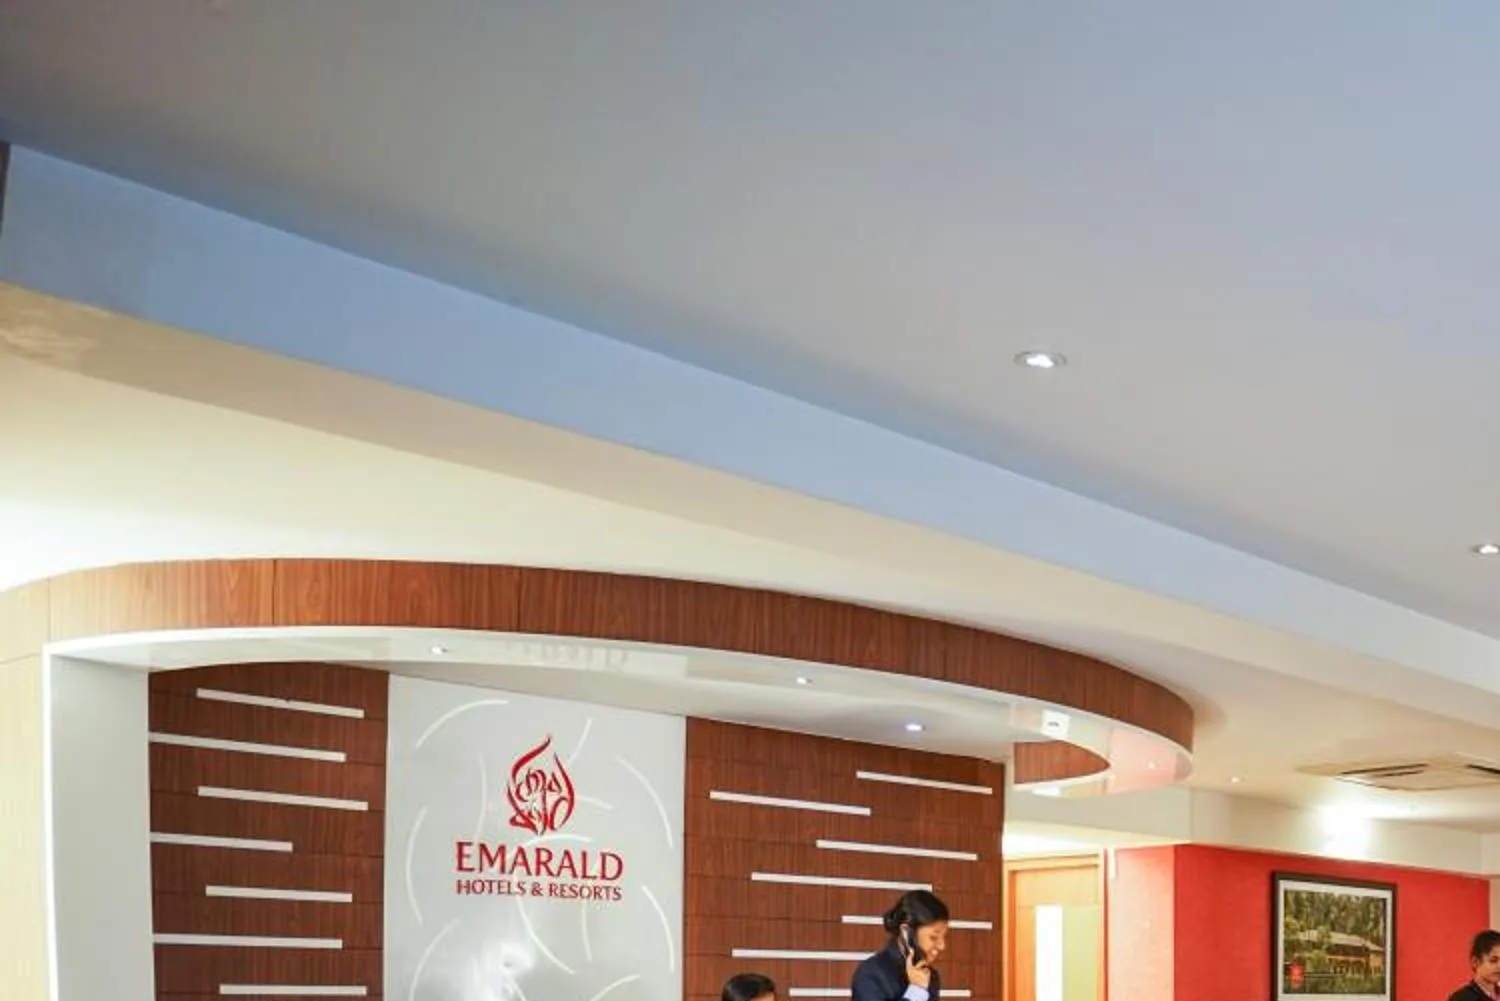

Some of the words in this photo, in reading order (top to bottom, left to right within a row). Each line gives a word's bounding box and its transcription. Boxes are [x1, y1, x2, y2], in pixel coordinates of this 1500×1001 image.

[455, 841, 624, 881] EMARALD
[456, 879, 527, 896] HOTELS
[531, 881, 544, 897] &
[548, 882, 623, 901] RESORTS
